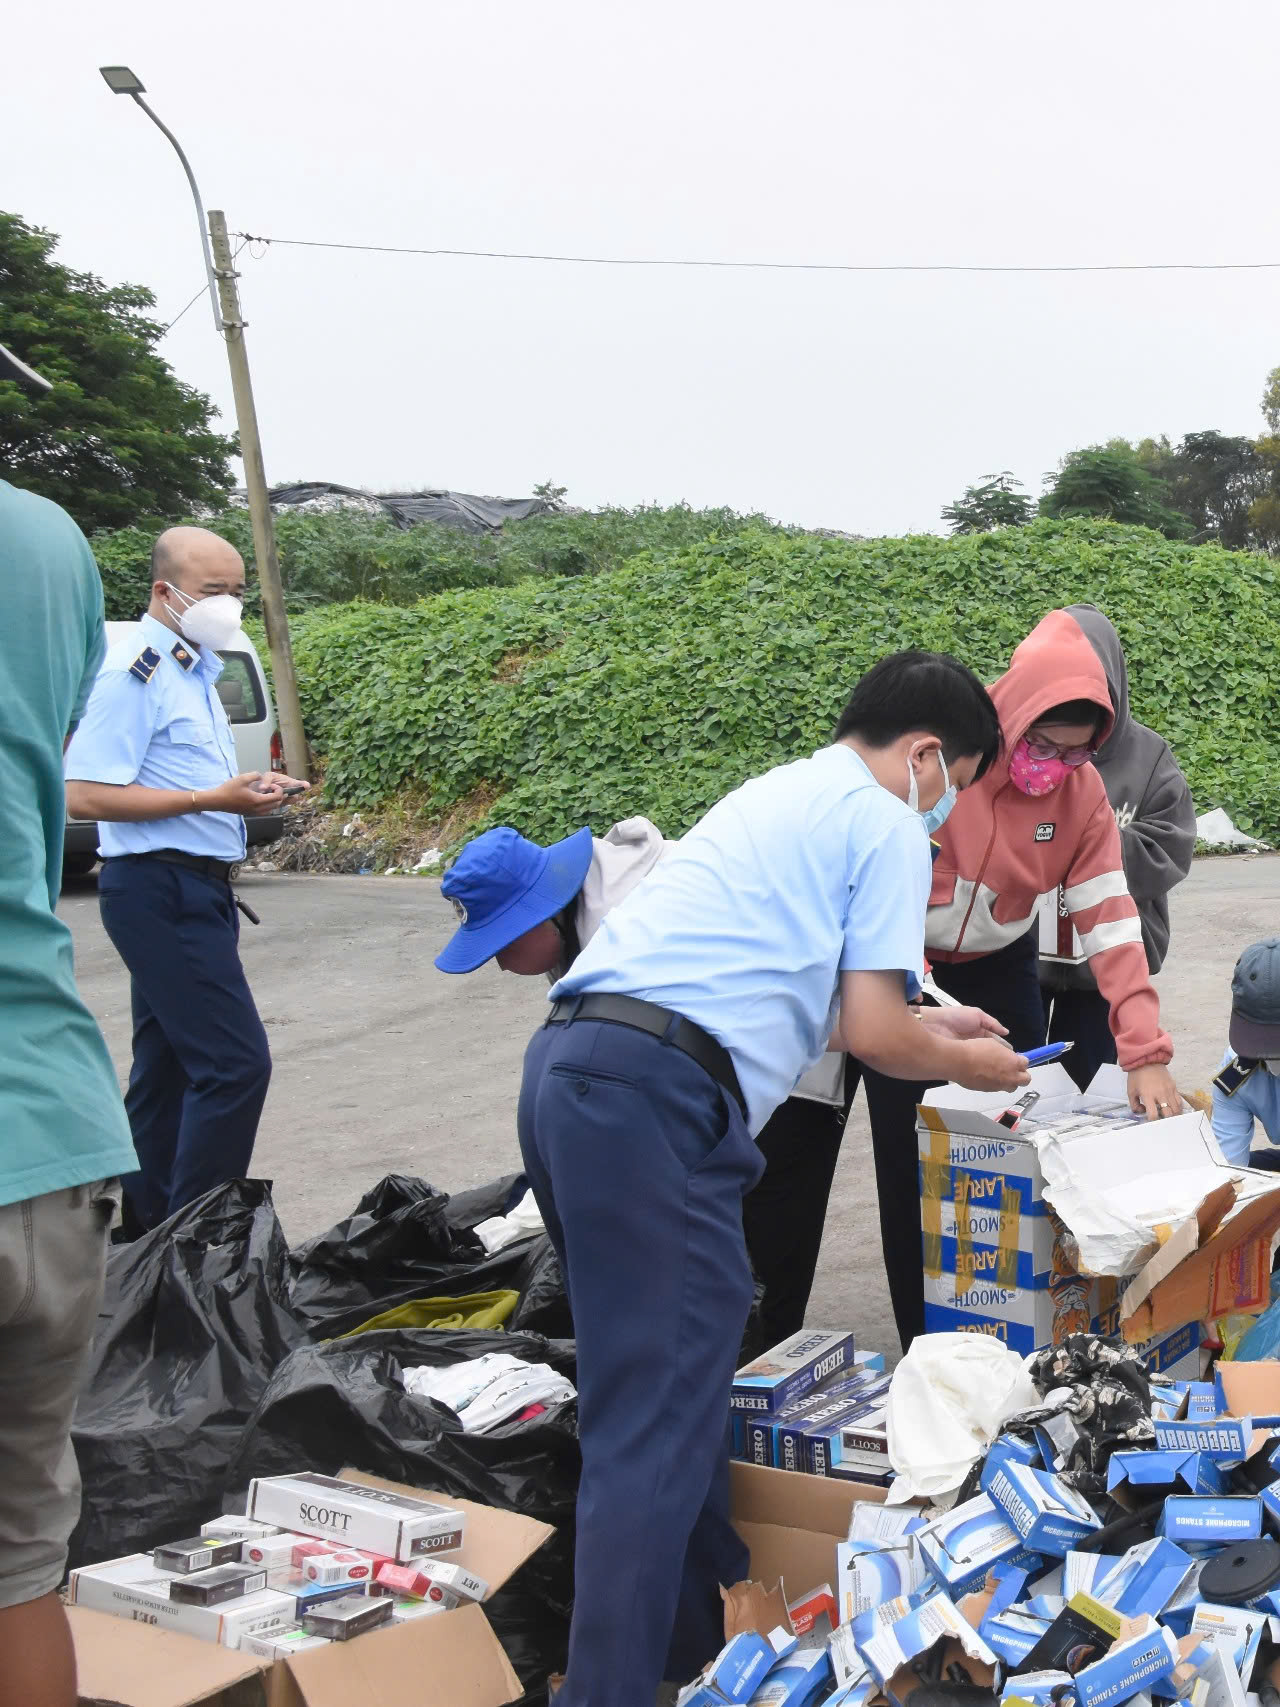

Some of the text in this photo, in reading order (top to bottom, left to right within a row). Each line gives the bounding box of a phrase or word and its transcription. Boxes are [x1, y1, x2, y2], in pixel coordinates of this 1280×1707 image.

[951, 1142, 1006, 1163] SMOOTH
[954, 1288, 1007, 1308] SMOOTH
[786, 1334, 833, 1358] HERO
[813, 1346, 845, 1382] HERO
[802, 1398, 857, 1423] HERO
[753, 1429, 764, 1466] ERO
[784, 1435, 795, 1472] ERO
[851, 1438, 881, 1451] SCOTT
[814, 1441, 827, 1477] HER
[299, 1502, 352, 1531] SCOTT
[1176, 1517, 1250, 1528] MICROPHONE STANDS
[420, 1534, 455, 1550] SCOTT
[461, 1576, 480, 1591] JET
[1086, 1655, 1169, 1707] MICROPHONE STANDS
